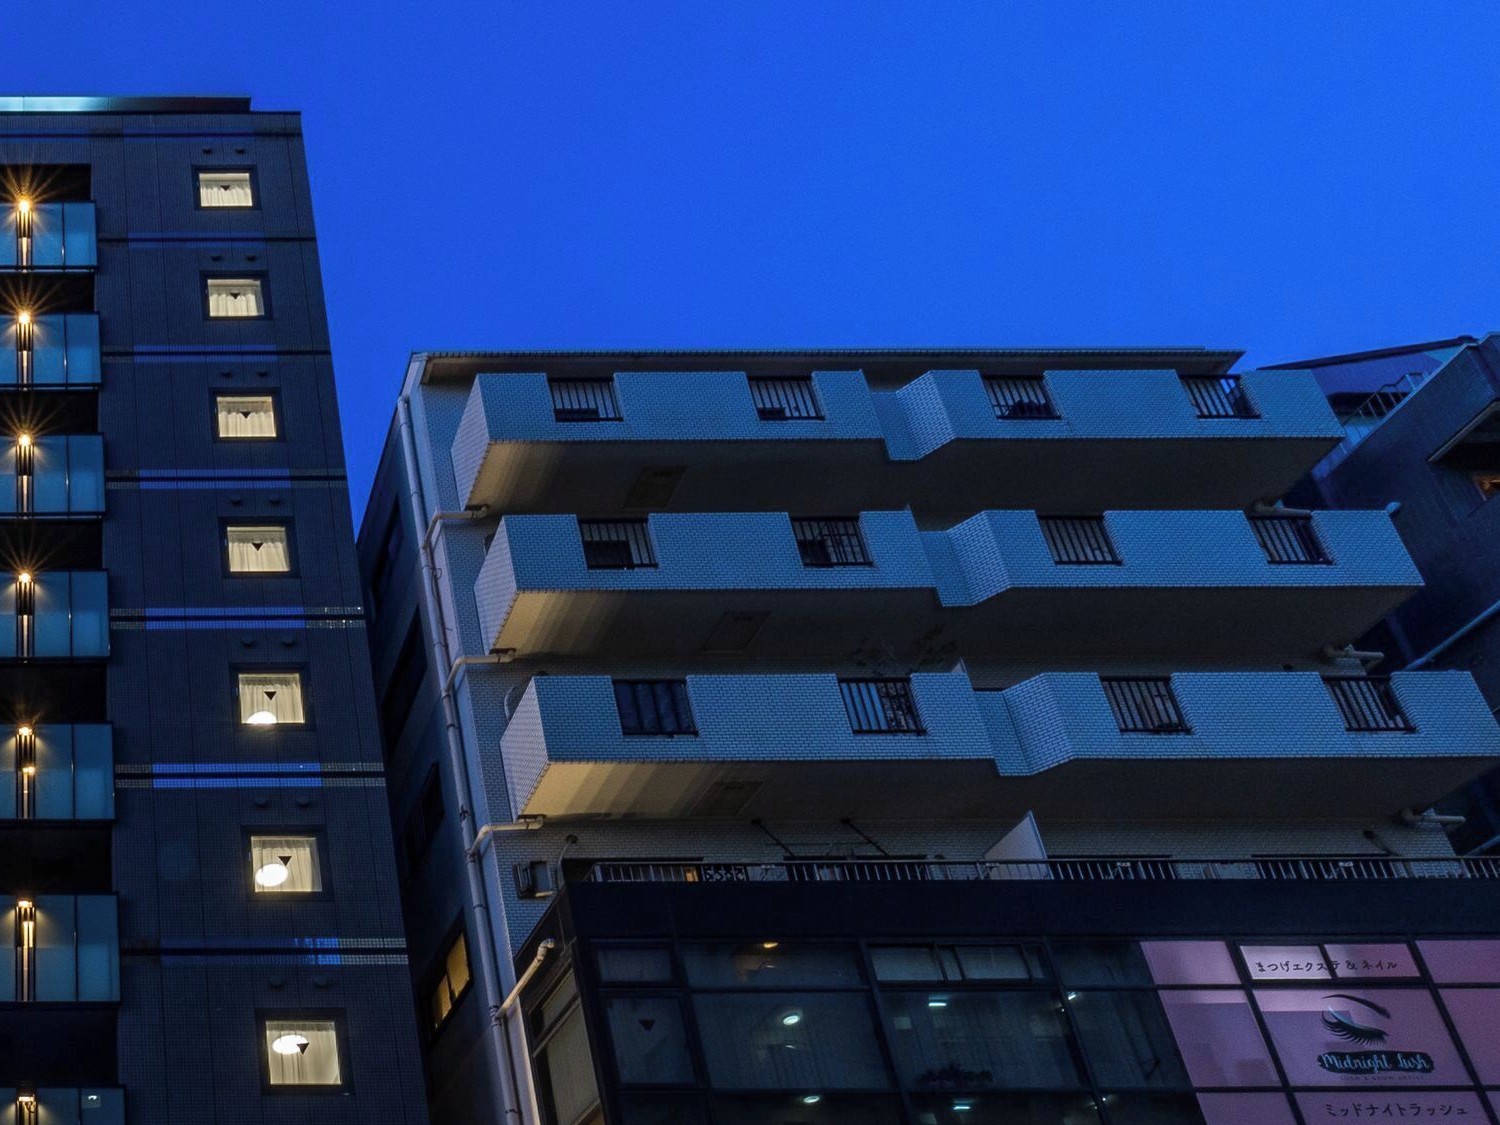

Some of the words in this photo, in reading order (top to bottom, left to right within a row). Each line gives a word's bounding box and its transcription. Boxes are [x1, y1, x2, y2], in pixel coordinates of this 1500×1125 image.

[1321, 1054, 1390, 1073] Midnight
[1325, 1103, 1468, 1117] ミッドナイトラッシュ
